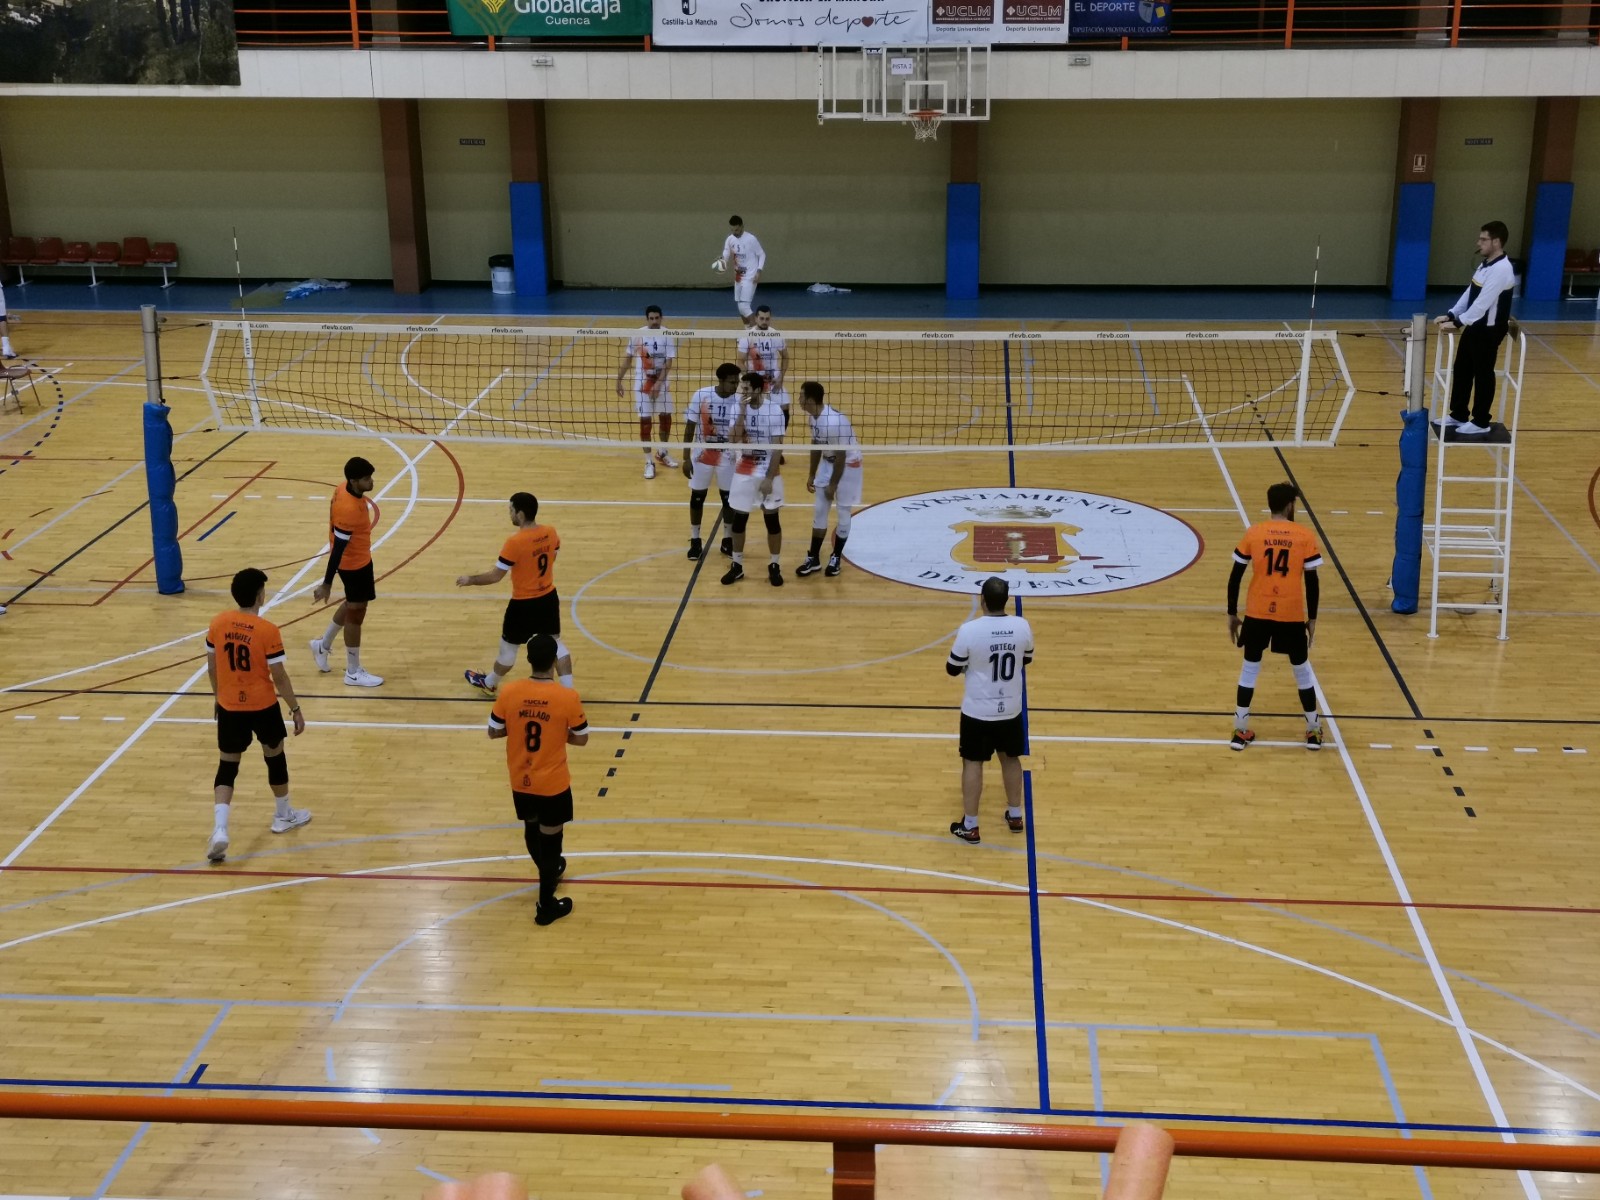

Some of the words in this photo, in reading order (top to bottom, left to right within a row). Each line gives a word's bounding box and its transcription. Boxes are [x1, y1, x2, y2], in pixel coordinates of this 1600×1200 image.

[514, 0, 621, 20] Globalcaja
[946, 5, 992, 17] UCLM
[1016, 5, 1062, 17] UCLM
[1074, 2, 1086, 12] EL
[1090, 2, 1136, 12] DEPORTE
[545, 15, 591, 25] Cuenca
[730, 2, 805, 28] Somos
[662, 18, 693, 26] Castilla-La
[695, 18, 718, 26] Mancha
[237, 322, 269, 330] rfb.com
[491, 327, 523, 335] rfevb.com
[761, 341, 770, 352] 14
[751, 415, 756, 427] 8
[901, 493, 1133, 515] AYUNTAMIENTO
[1264, 539, 1293, 548] ALONSO
[538, 553, 548, 578] 9
[1264, 547, 1290, 577] 14
[918, 570, 964, 585] DE
[225, 632, 252, 645] MIGUEL
[989, 643, 1016, 652] ORTEGA
[224, 642, 251, 672] 18
[989, 652, 1016, 683] 10
[519, 709, 551, 722] MELLADO
[525, 720, 542, 753] 8
